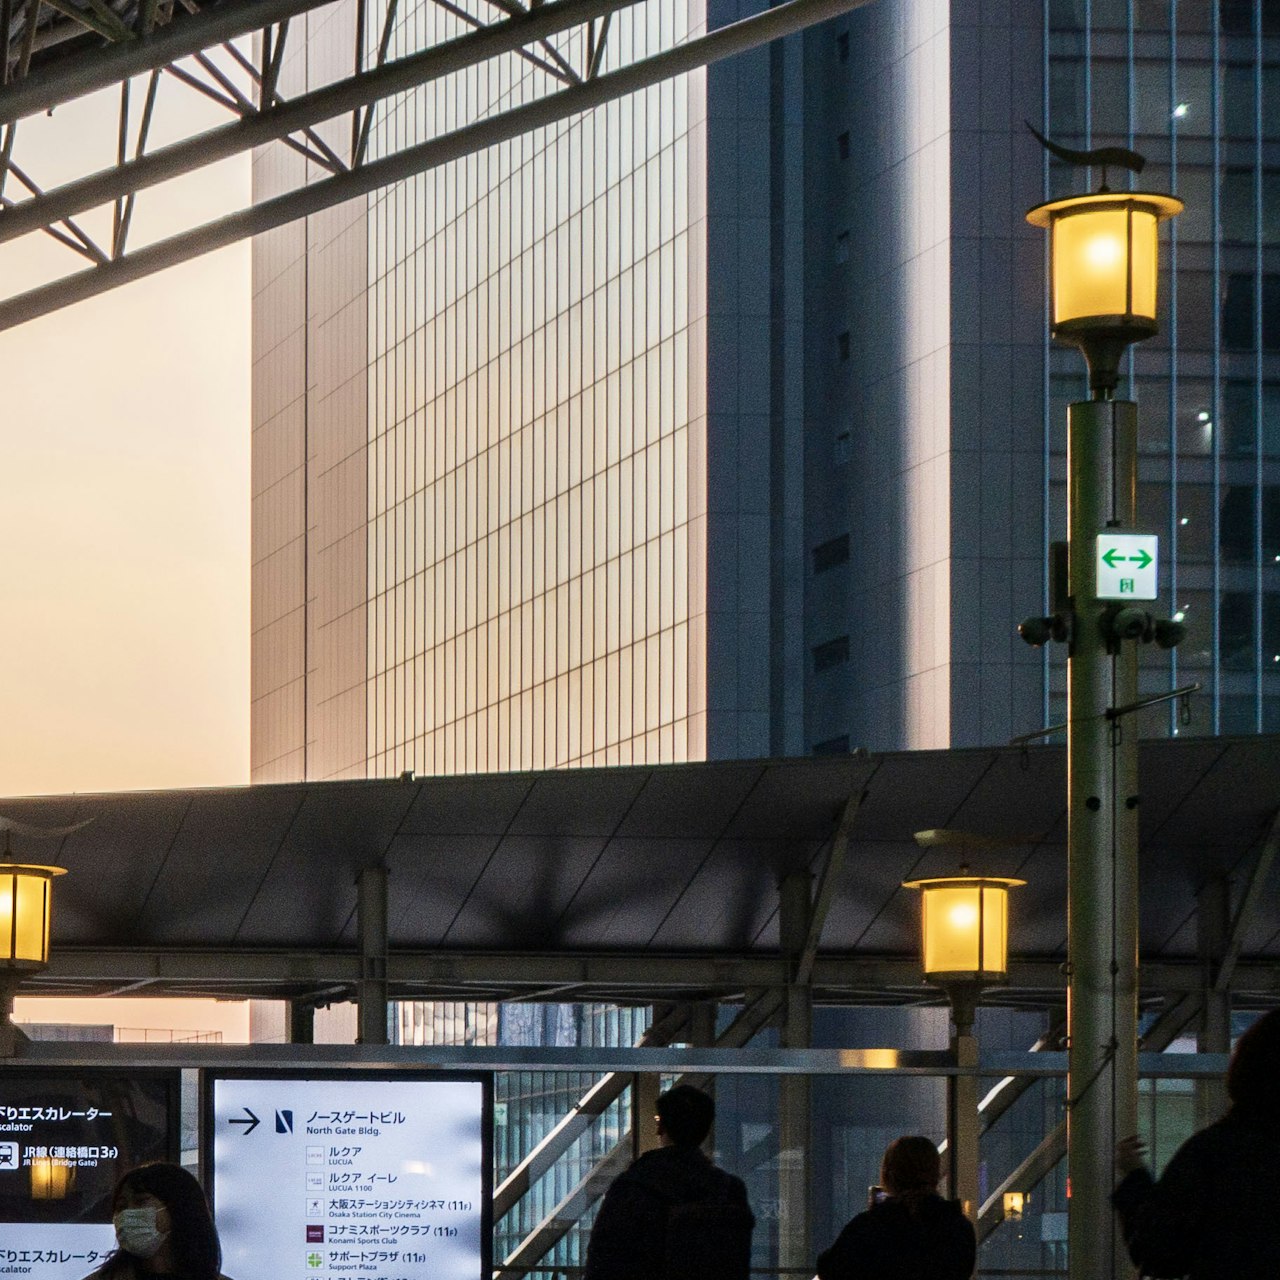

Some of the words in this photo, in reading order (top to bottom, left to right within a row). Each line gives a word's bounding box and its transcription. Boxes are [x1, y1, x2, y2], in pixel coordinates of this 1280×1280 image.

[307, 1111, 406, 1124] ノースゲートビル
[307, 1127, 332, 1135] North
[335, 1127, 356, 1135] Gate
[358, 1127, 381, 1137] Bldg.
[329, 1147, 362, 1157] ルクア
[52, 1160, 77, 1168] (Bridge
[78, 1160, 98, 1168] Gate)
[329, 1173, 362, 1183] ルクア
[367, 1173, 398, 1184] イーレ
[329, 1199, 445, 1210] 大阪ステーションシティシネマ
[448, 1200, 472, 1211] (11F)
[380, 1211, 393, 1219] City
[328, 1225, 431, 1236] コナミスポーツクラブ
[433, 1227, 458, 1237] (11F)
[358, 1238, 380, 1246] Sports
[328, 1251, 399, 1262] サポートプラザ
[402, 1253, 426, 1263] (11F)
